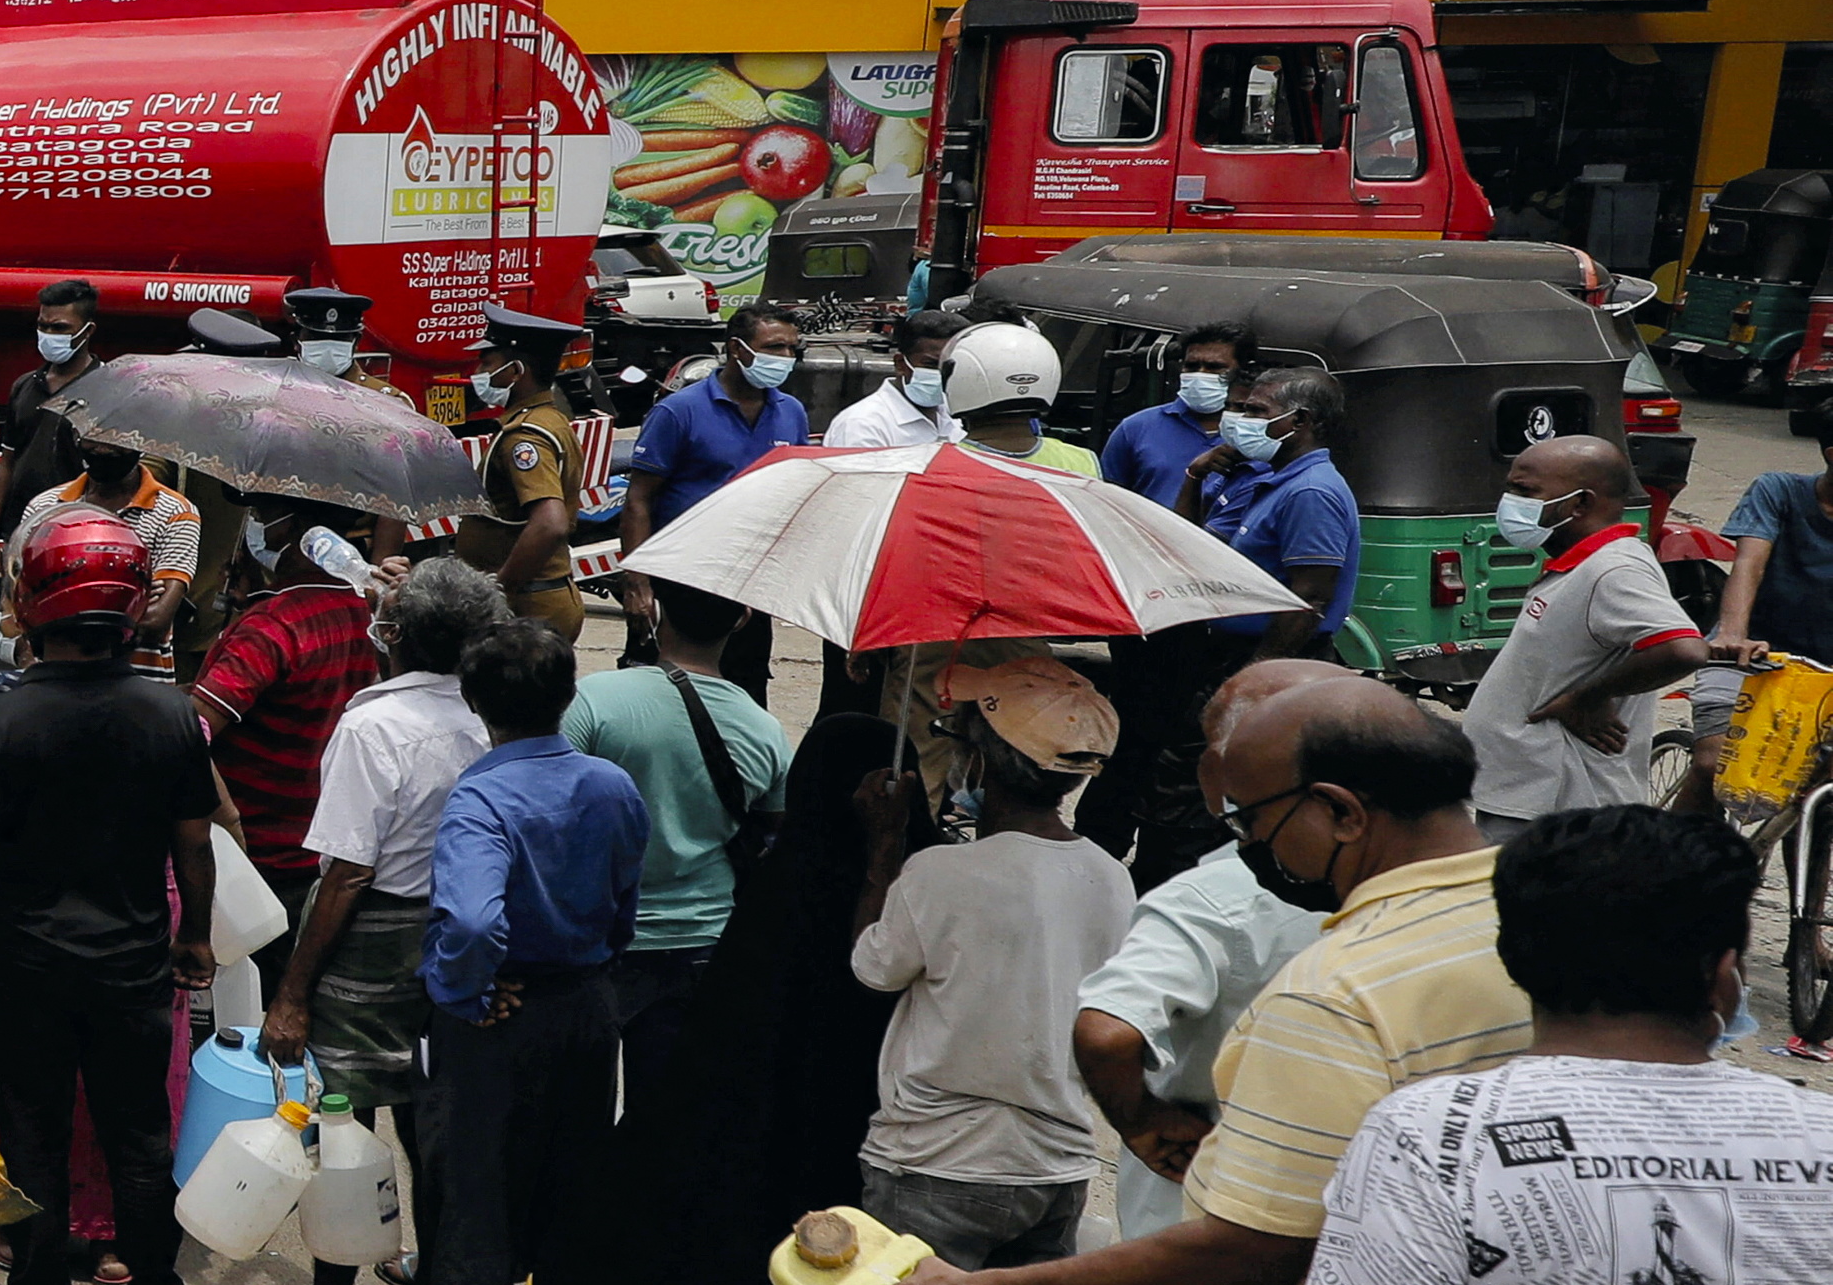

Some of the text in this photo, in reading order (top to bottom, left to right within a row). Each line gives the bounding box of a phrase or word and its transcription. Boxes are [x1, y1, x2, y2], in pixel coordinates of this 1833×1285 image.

[354, 9, 446, 125] HIGHLY
[851, 64, 936, 81] LAUGF
[143, 91, 217, 116] (Pvt)
[223, 91, 282, 115] Ltd.
[137, 119, 254, 133] Road
[1084, 157, 1131, 168] Transport
[1132, 157, 1170, 166] Service
[398, 190, 550, 212] LUBRICNS
[425, 218, 442, 232] The
[443, 218, 464, 231] Best
[465, 217, 488, 230] From
[506, 217, 526, 229] Best
[422, 251, 452, 277] Super
[497, 247, 520, 270] Pvt)
[409, 273, 489, 288] Kaluthara
[144, 281, 251, 304] NO SMOKING
[430, 287, 508, 300] Batago
[418, 314, 490, 329] 0342208
[416, 326, 488, 343] 0771419
[432, 401, 461, 424] 3984
[1497, 1120, 1561, 1144] SPORT
[1506, 1139, 1565, 1162] NEWS
[1571, 1155, 1746, 1184] EDITORIAL
[1486, 1189, 1536, 1276] TOWN HALL
[1511, 1193, 1554, 1263] MEETING
